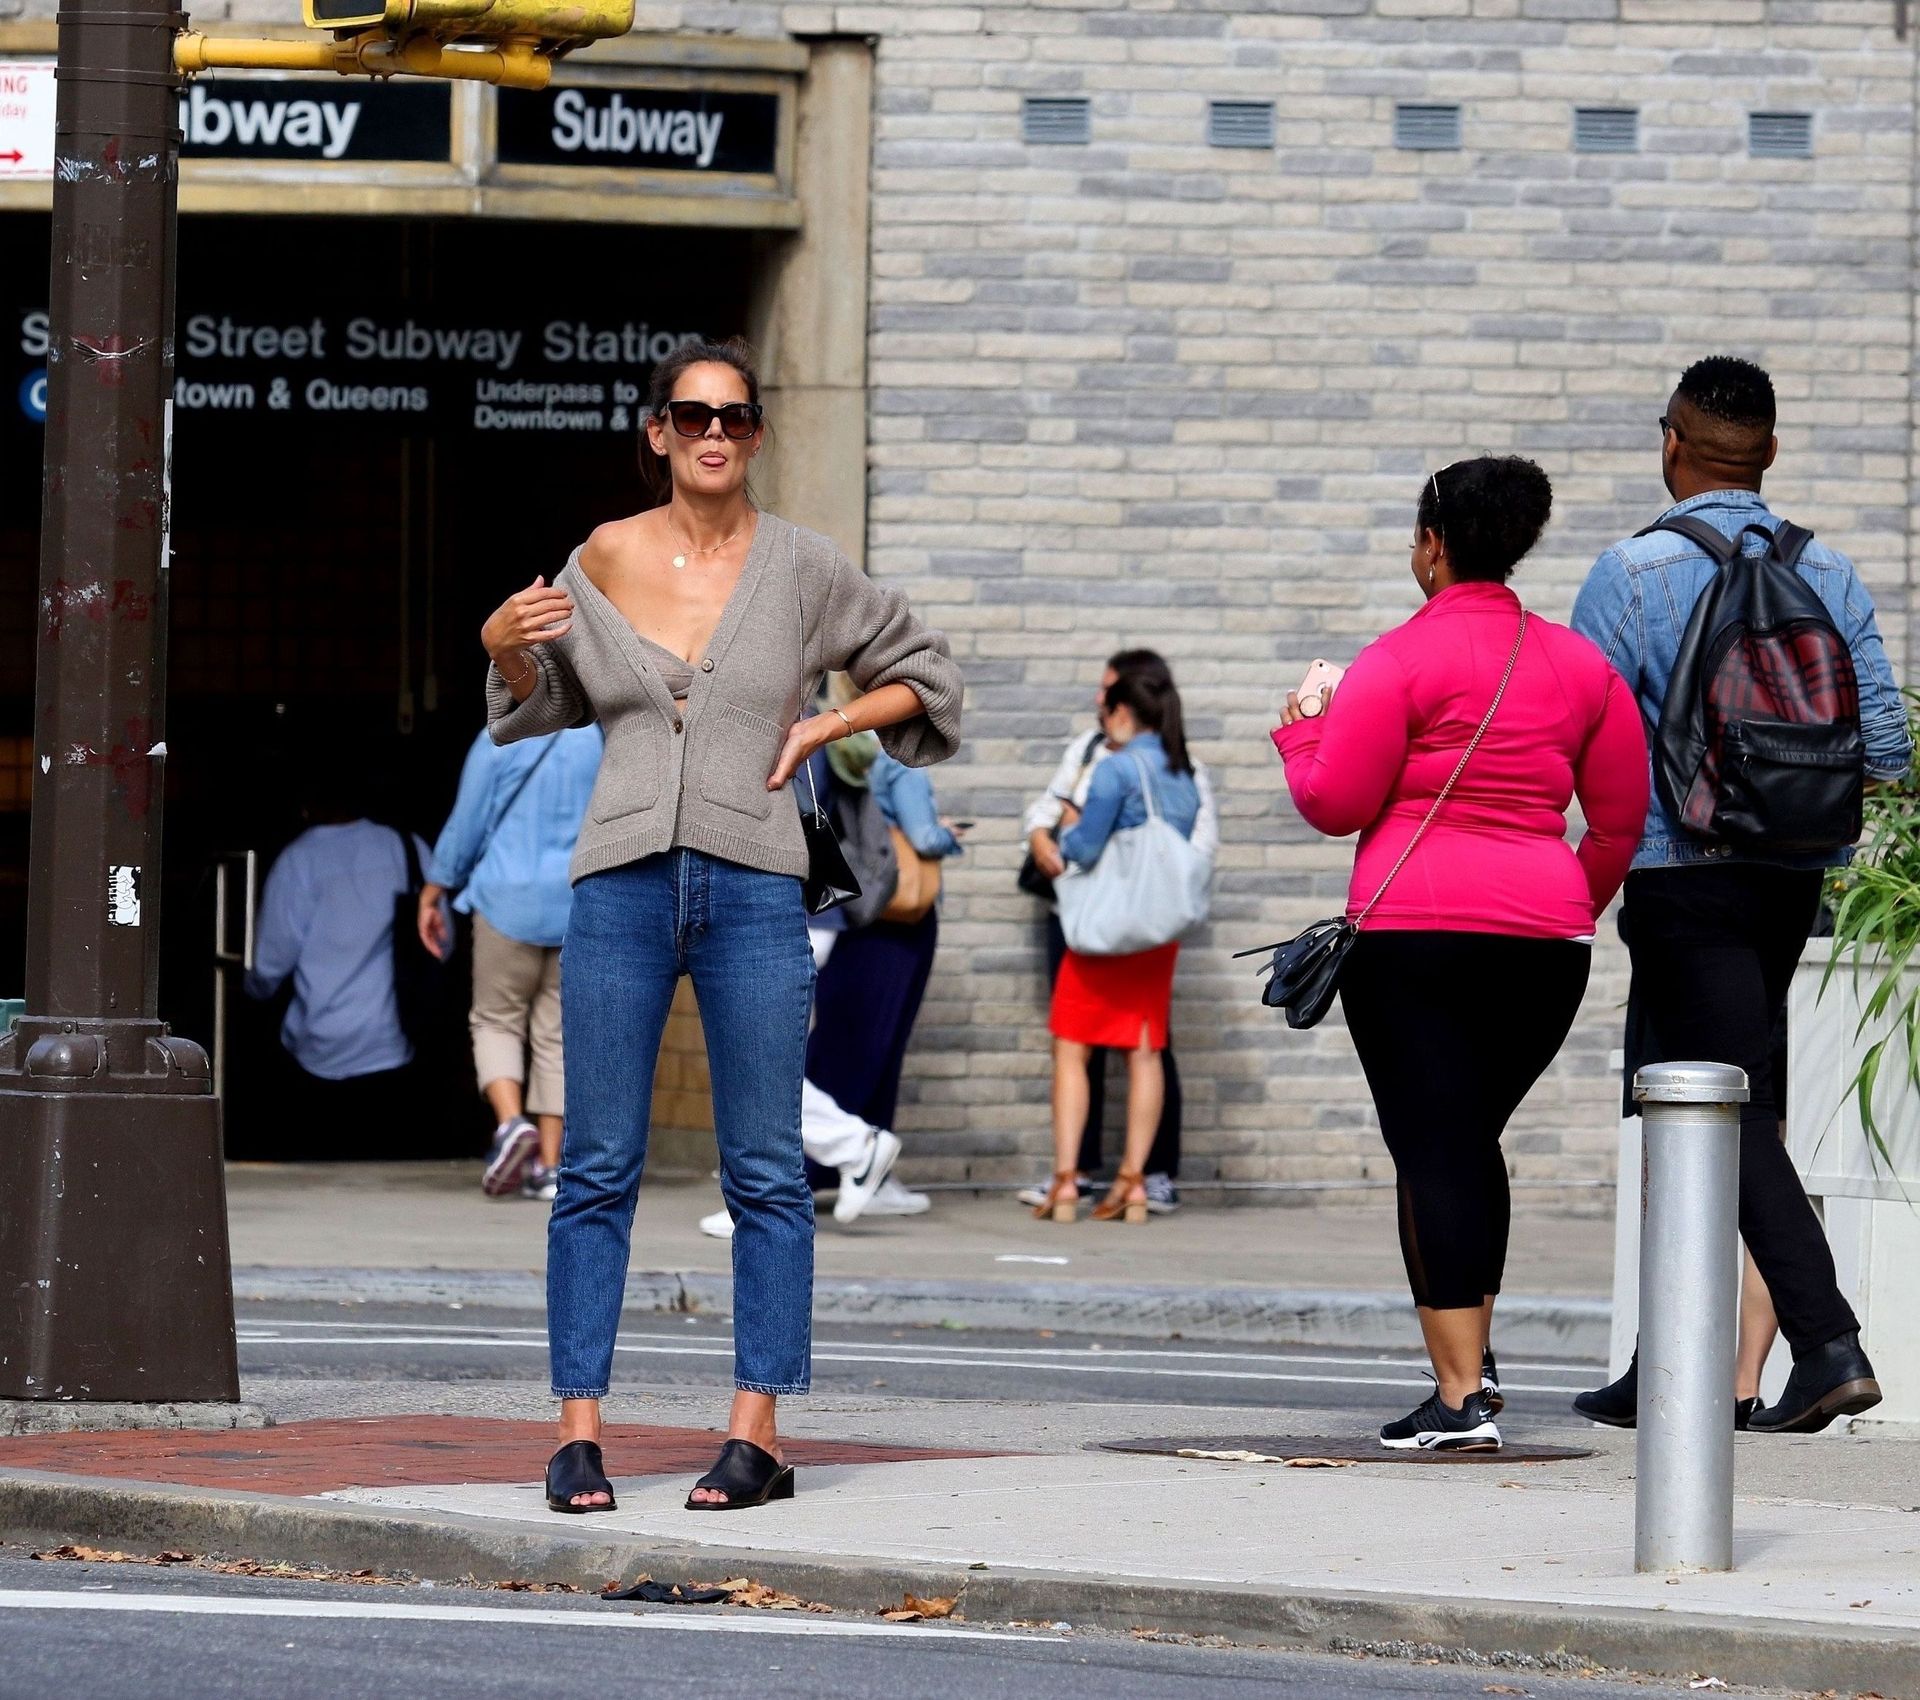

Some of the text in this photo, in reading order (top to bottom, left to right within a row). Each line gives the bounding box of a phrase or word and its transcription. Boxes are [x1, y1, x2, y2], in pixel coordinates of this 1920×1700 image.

[552, 90, 723, 167] Subway
[185, 314, 326, 358] Street
[346, 317, 522, 370] Subway
[267, 377, 291, 409] &
[305, 378, 429, 411] Queens
[476, 378, 639, 405] Underpass to
[474, 404, 602, 430] Downtown
[610, 405, 630, 430] &
